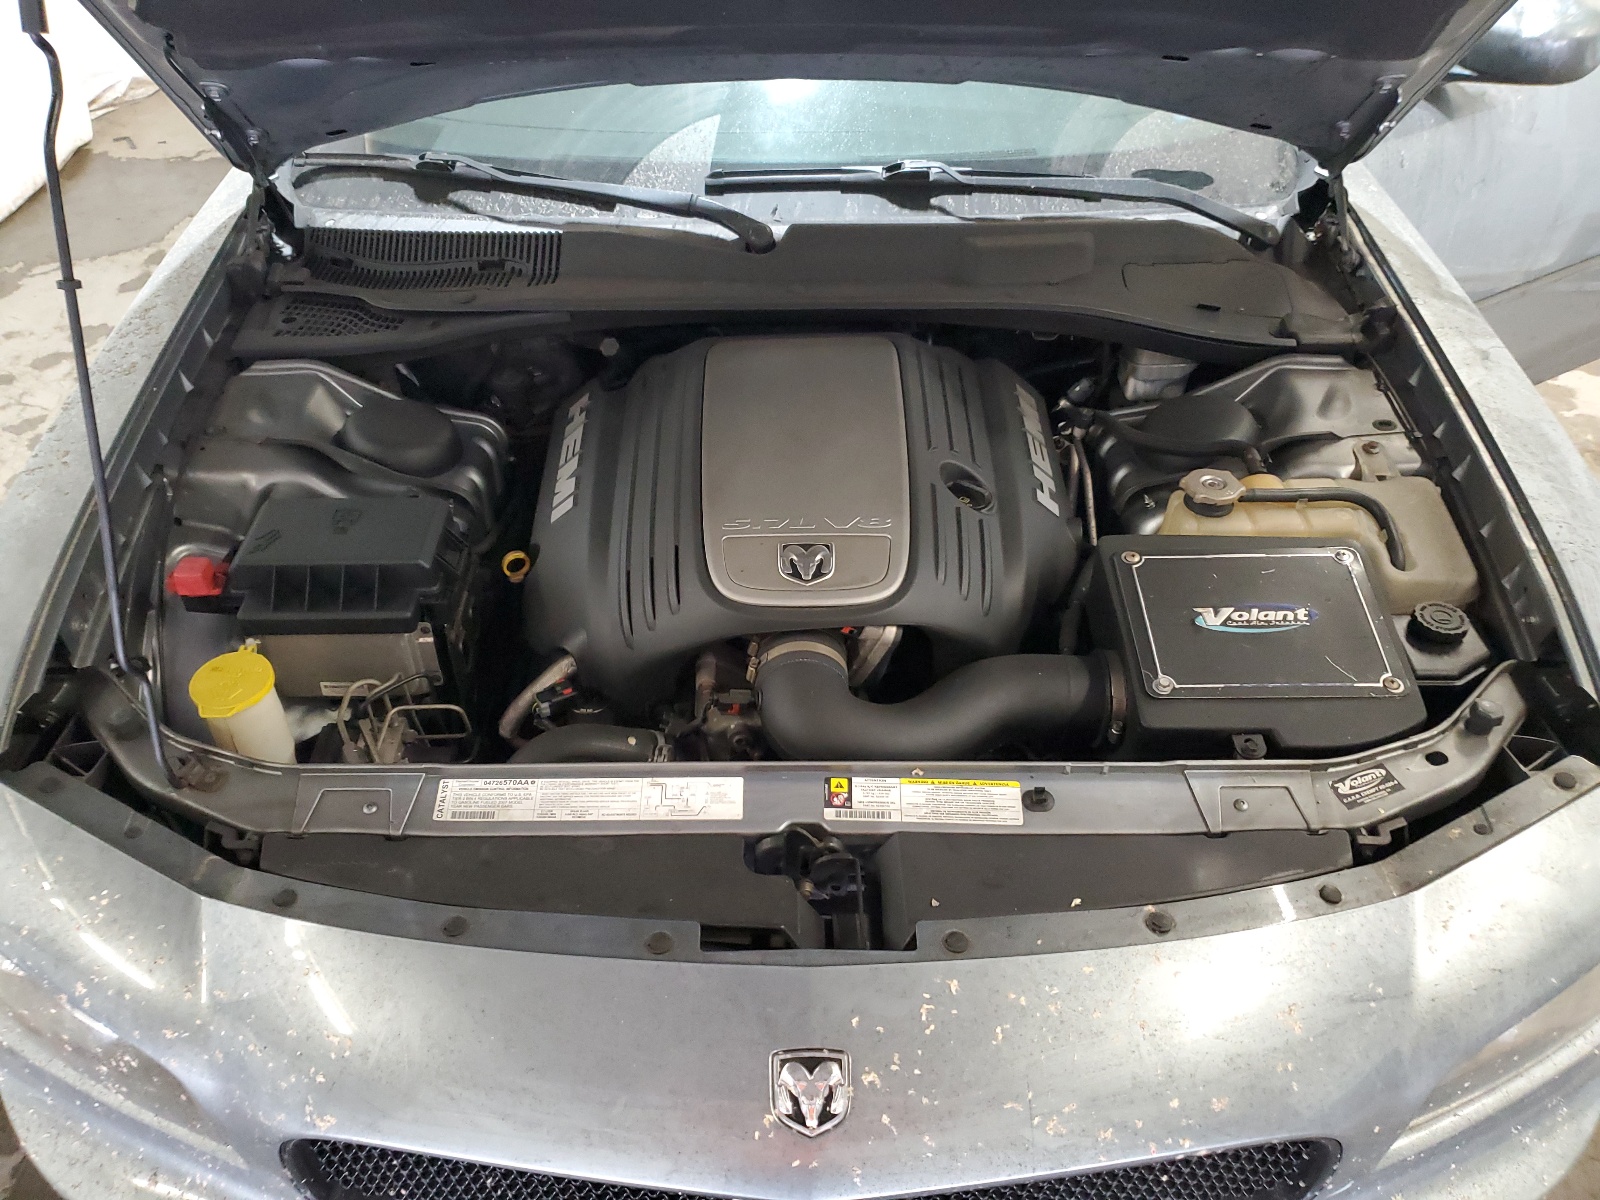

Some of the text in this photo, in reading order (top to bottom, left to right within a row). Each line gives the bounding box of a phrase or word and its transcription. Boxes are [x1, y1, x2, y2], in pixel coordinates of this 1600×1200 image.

[550, 392, 590, 524] HEMI
[1015, 383, 1060, 517] HEMI
[824, 516, 892, 530] V8
[1192, 606, 1309, 626] Volant
[1333, 769, 1384, 792] Volant
[436, 780, 450, 819] CATALYST
